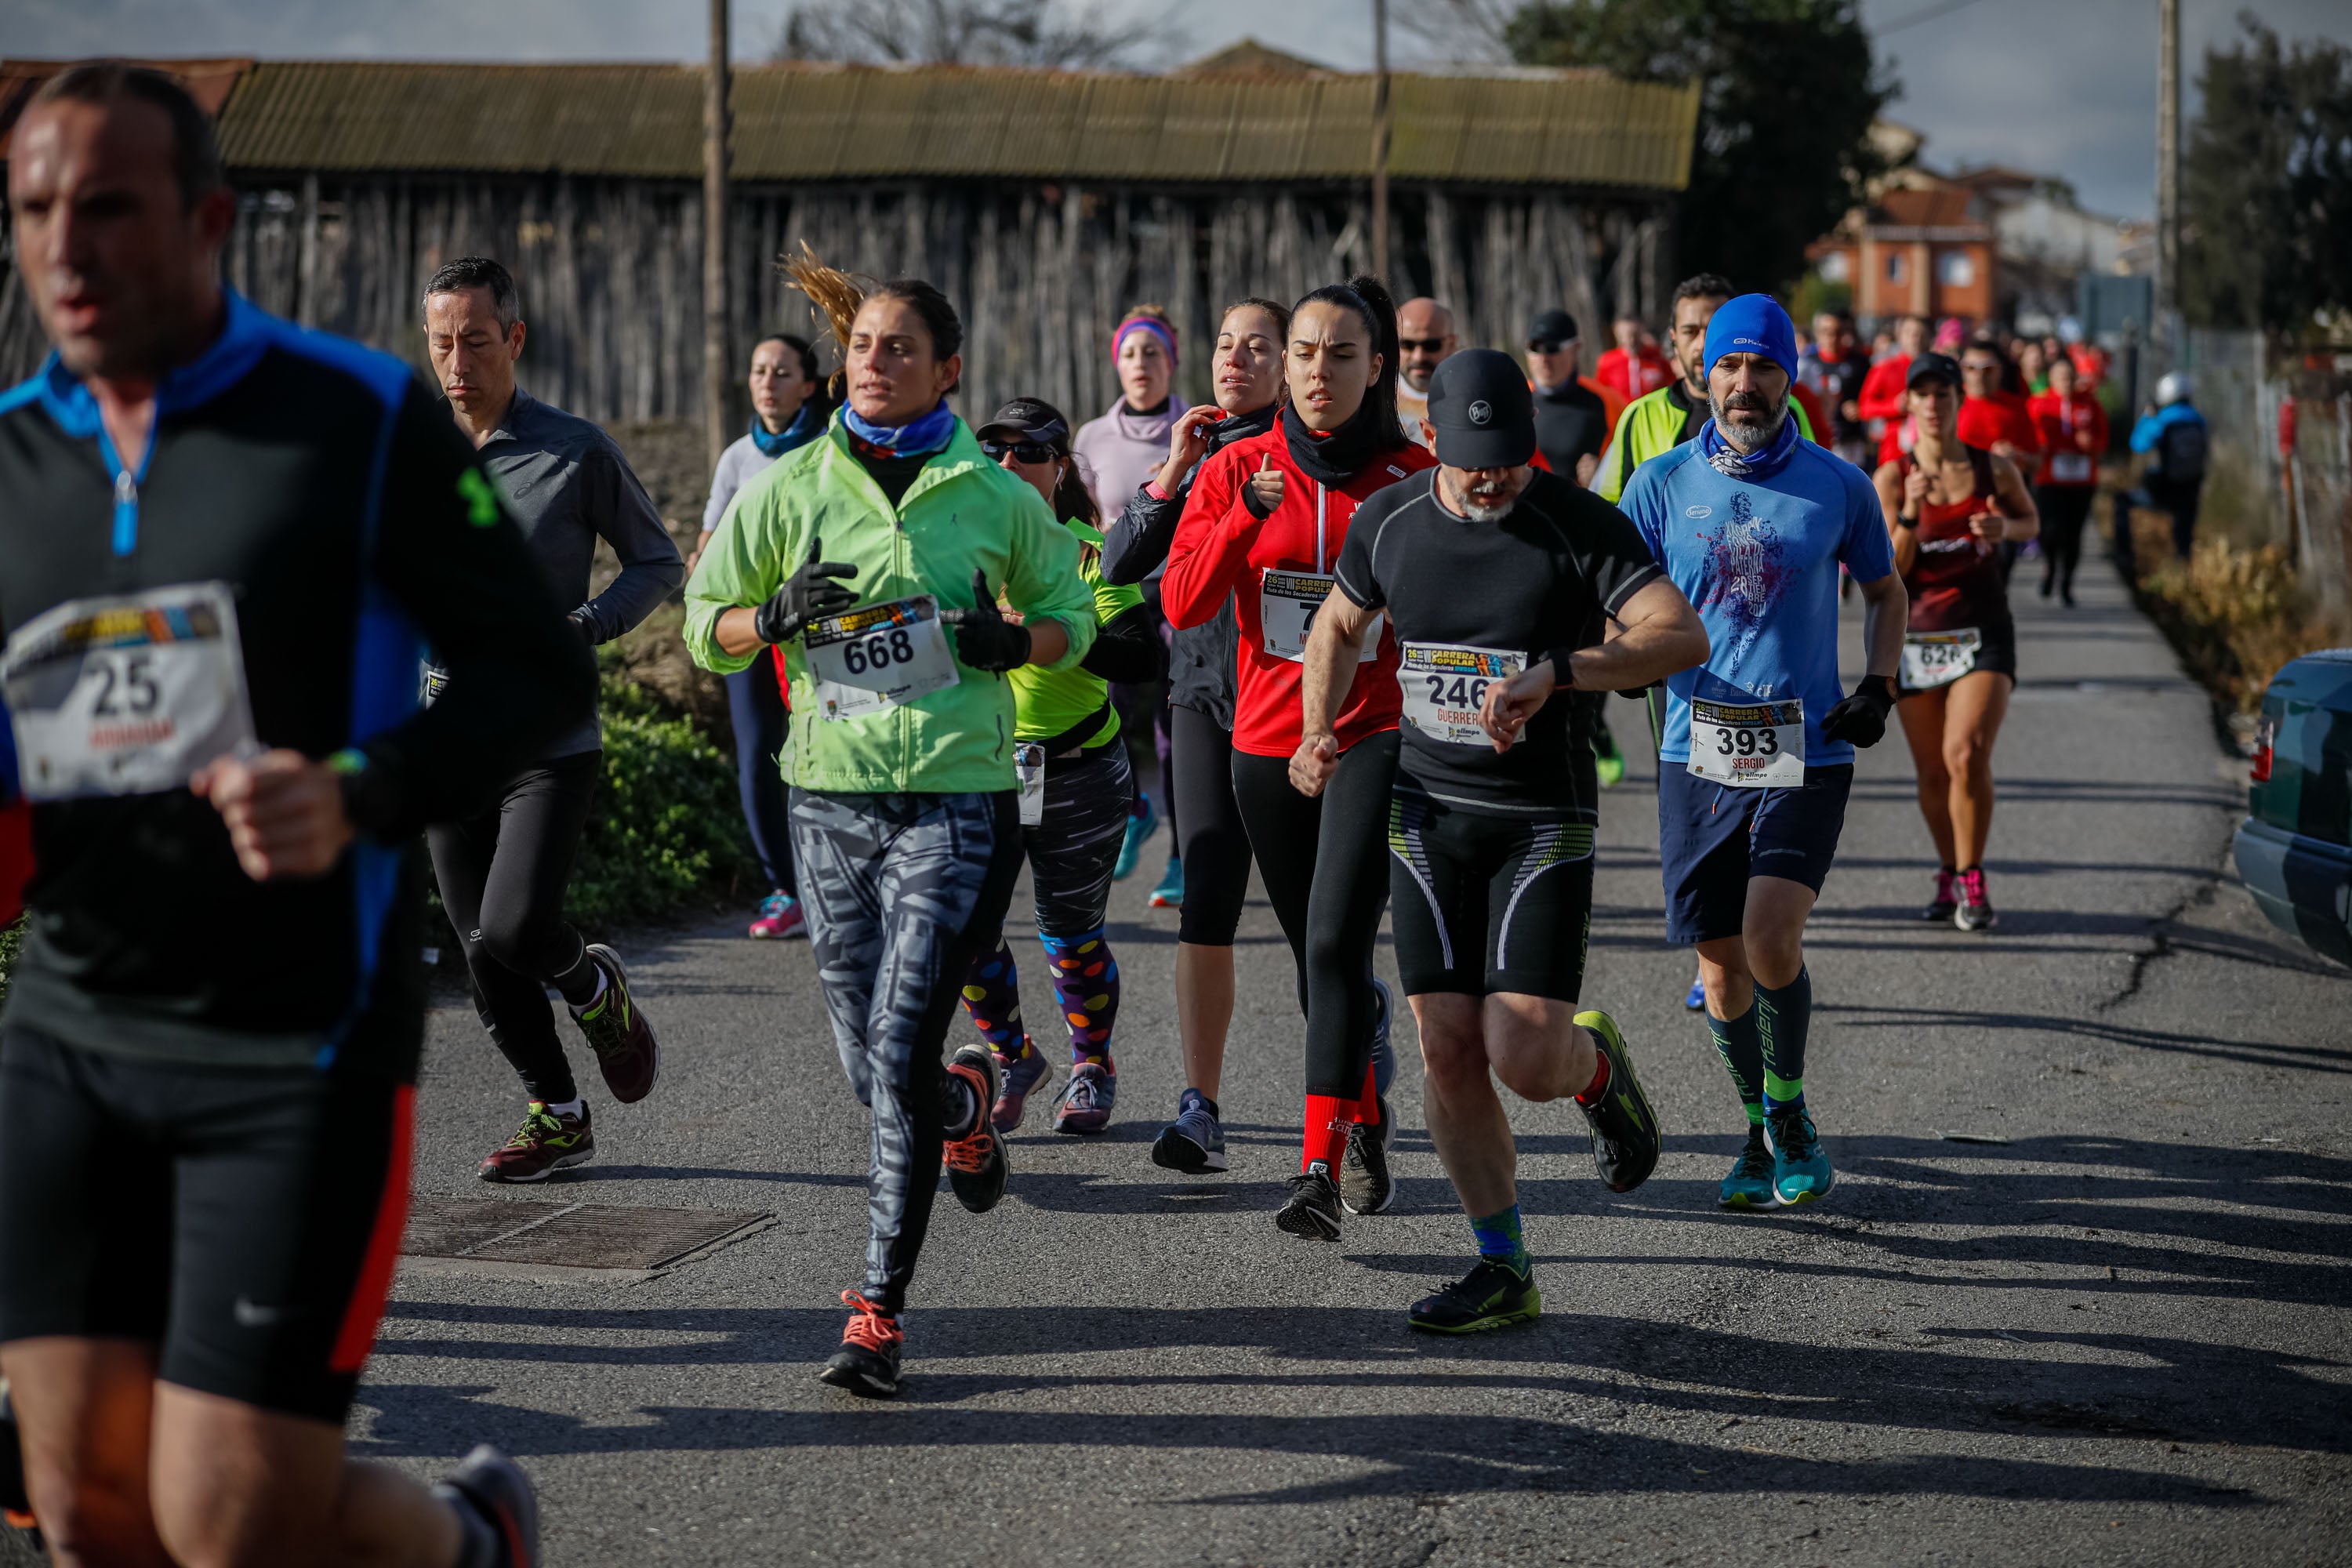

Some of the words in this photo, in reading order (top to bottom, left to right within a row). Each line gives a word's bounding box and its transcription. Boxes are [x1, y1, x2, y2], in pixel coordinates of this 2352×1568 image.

[1472, 406, 1490, 419] Buff
[1730, 555, 1764, 575] PATERNA
[1267, 575, 1278, 584] 26
[1294, 579, 1333, 587] CARRER
[1748, 575, 1762, 585] SEP
[1748, 592, 1766, 602] BRE
[1299, 602, 1320, 631] 7
[844, 630, 914, 674] 668
[1407, 649, 1417, 658] 26
[1431, 650, 1475, 660] CARRERA
[87, 657, 161, 717] 25
[1425, 675, 1490, 710] 246
[1696, 702, 1705, 712] 26
[1719, 707, 1759, 716] CARRERA
[1437, 708, 1479, 726] GUERRER
[1715, 728, 1778, 756] 393
[1732, 757, 1766, 769] SERGIO
[1755, 989, 1779, 1066] Kalenji
[1312, 1163, 1327, 1173] NIKE
